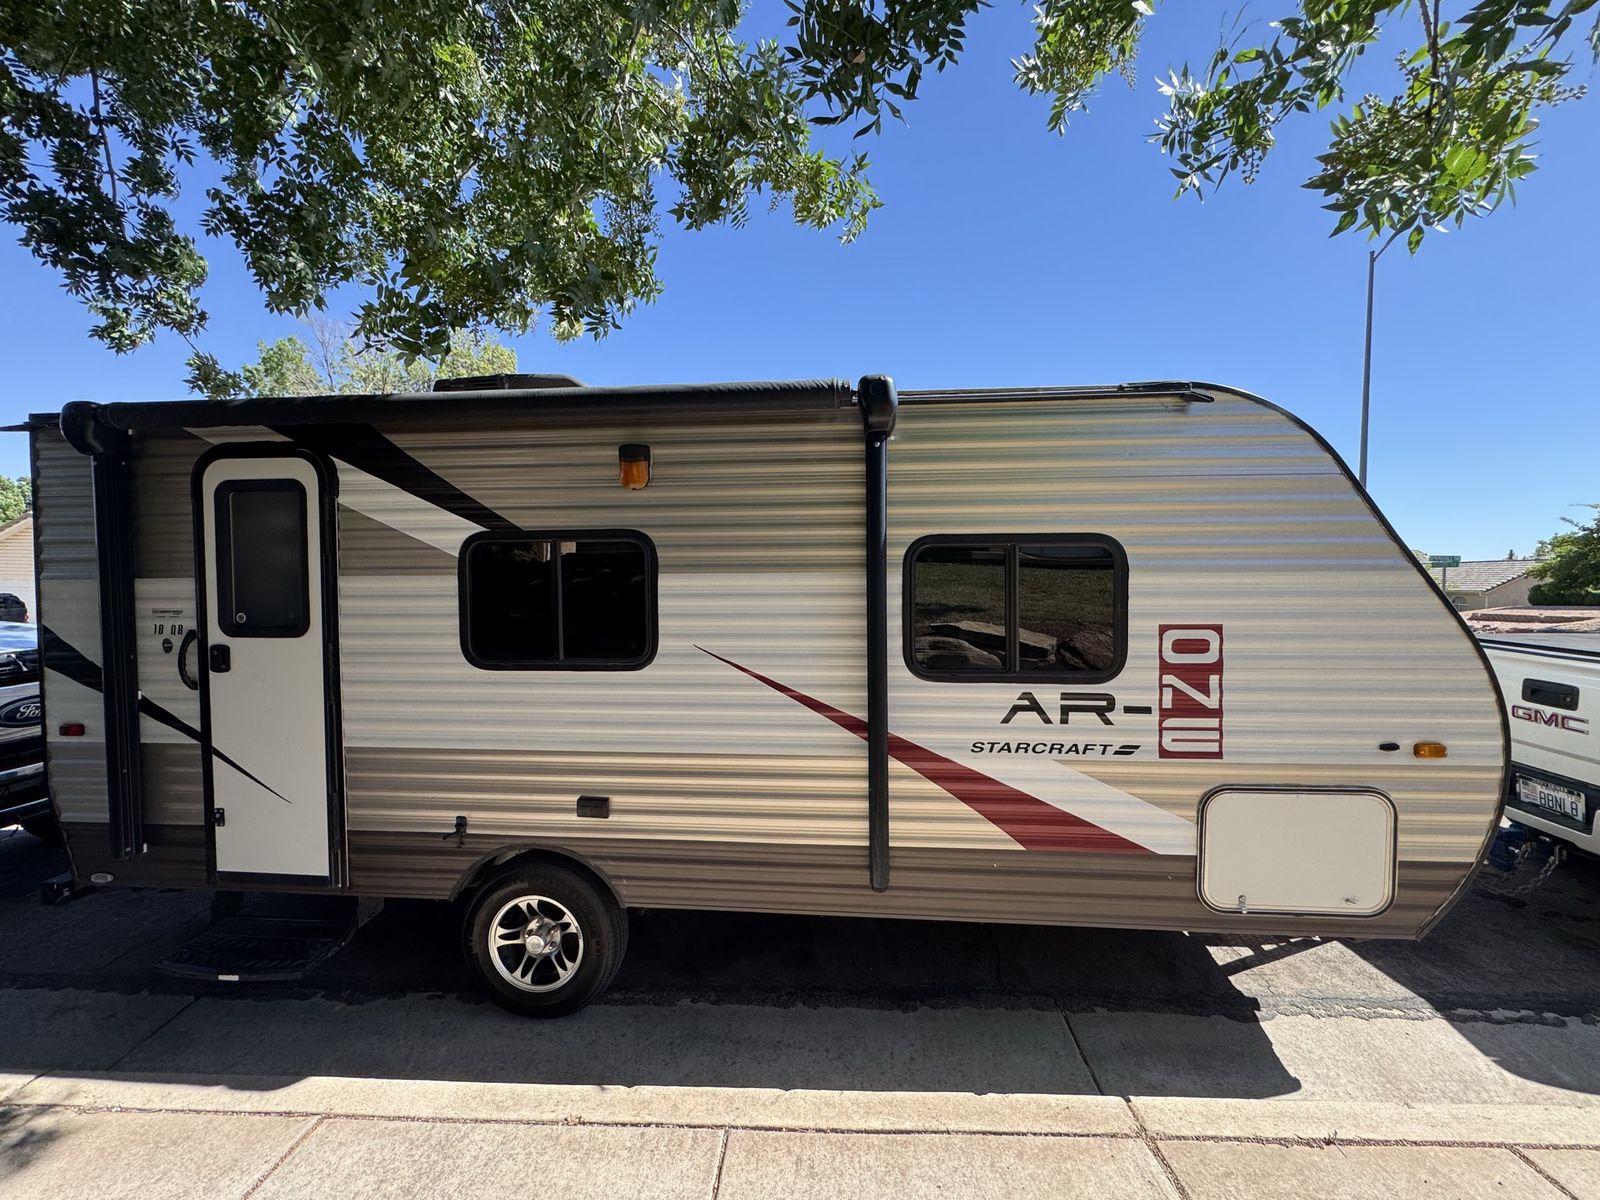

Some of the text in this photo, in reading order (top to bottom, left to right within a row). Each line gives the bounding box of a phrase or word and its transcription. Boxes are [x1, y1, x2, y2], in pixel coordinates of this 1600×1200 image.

[153, 623, 164, 635] 18
[1162, 629, 1220, 752] ONE
[1511, 704, 1589, 735] GMC
[970, 741, 1113, 756] STARCRAFT
